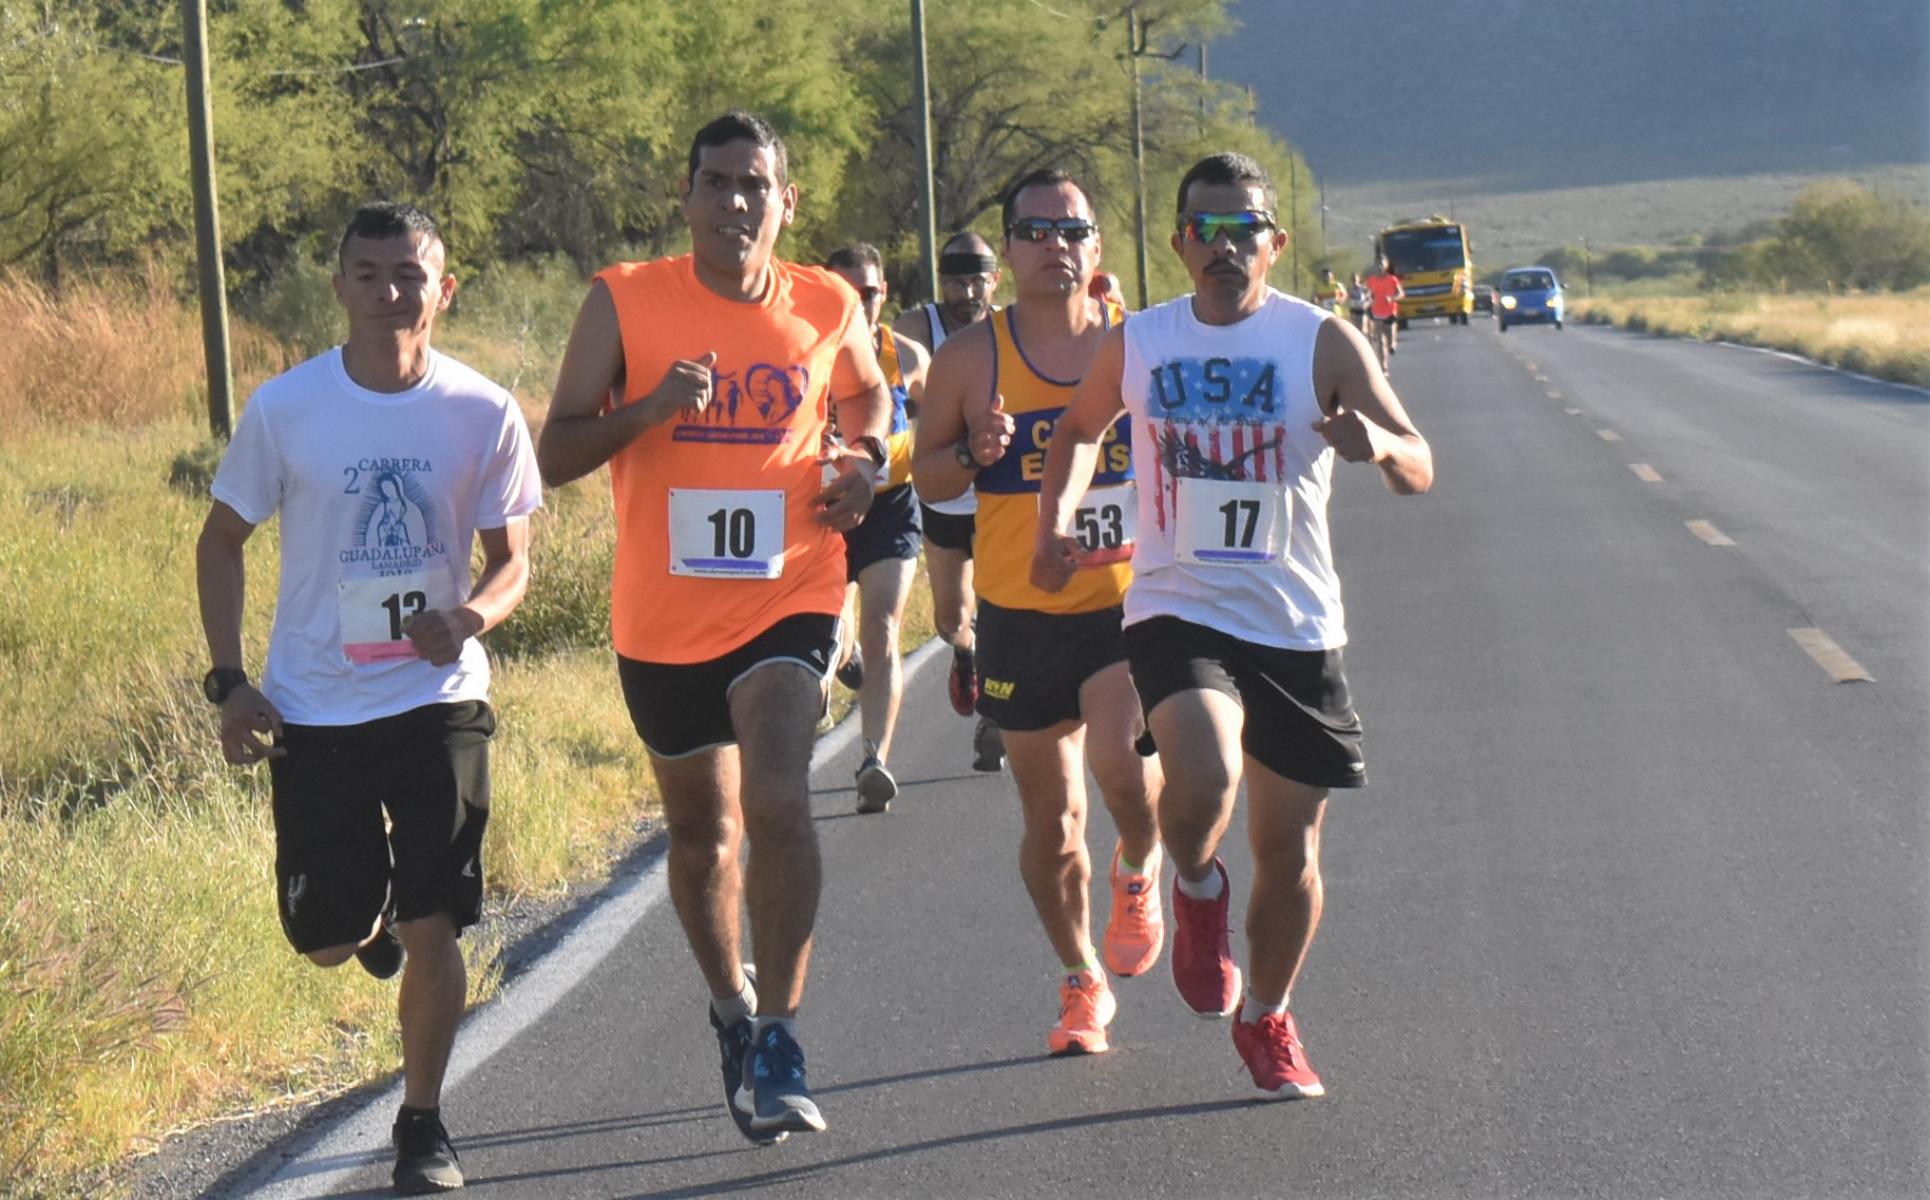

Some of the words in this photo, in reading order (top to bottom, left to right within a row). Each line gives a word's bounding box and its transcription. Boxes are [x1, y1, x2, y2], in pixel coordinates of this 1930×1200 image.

[1151, 357, 1275, 413] USA
[343, 466, 360, 494] 2
[358, 457, 432, 472] CARRERA
[707, 508, 755, 558] 10
[1075, 504, 1123, 552] 53
[1219, 499, 1260, 548] 17
